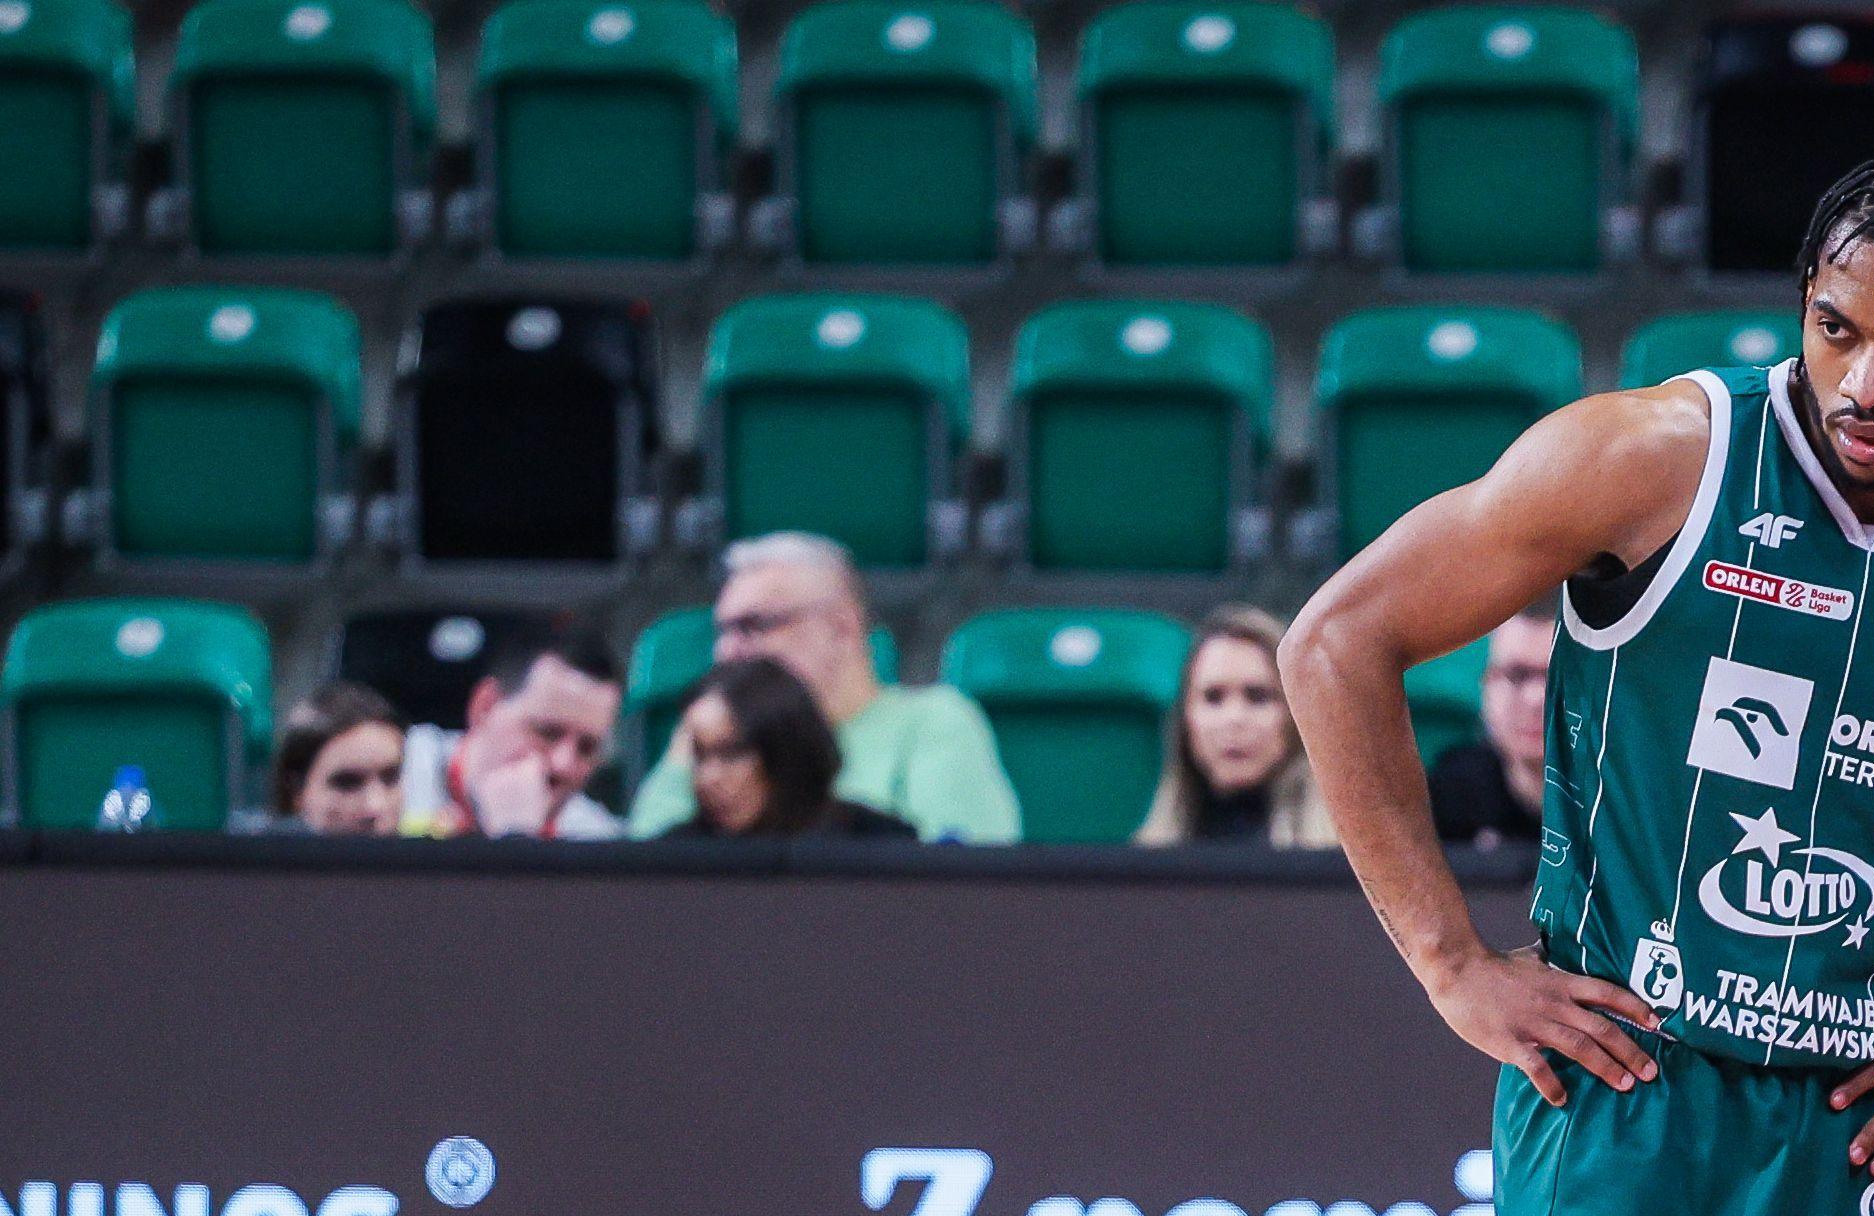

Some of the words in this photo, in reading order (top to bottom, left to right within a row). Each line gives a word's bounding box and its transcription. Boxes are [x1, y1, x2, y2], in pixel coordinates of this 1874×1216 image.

[1738, 512, 1805, 549] 4F
[1710, 568, 1778, 599] ORLEN
[1810, 588, 1847, 605] Basket
[1808, 599, 1831, 614] Liga
[1745, 859, 1856, 919] LOTTO
